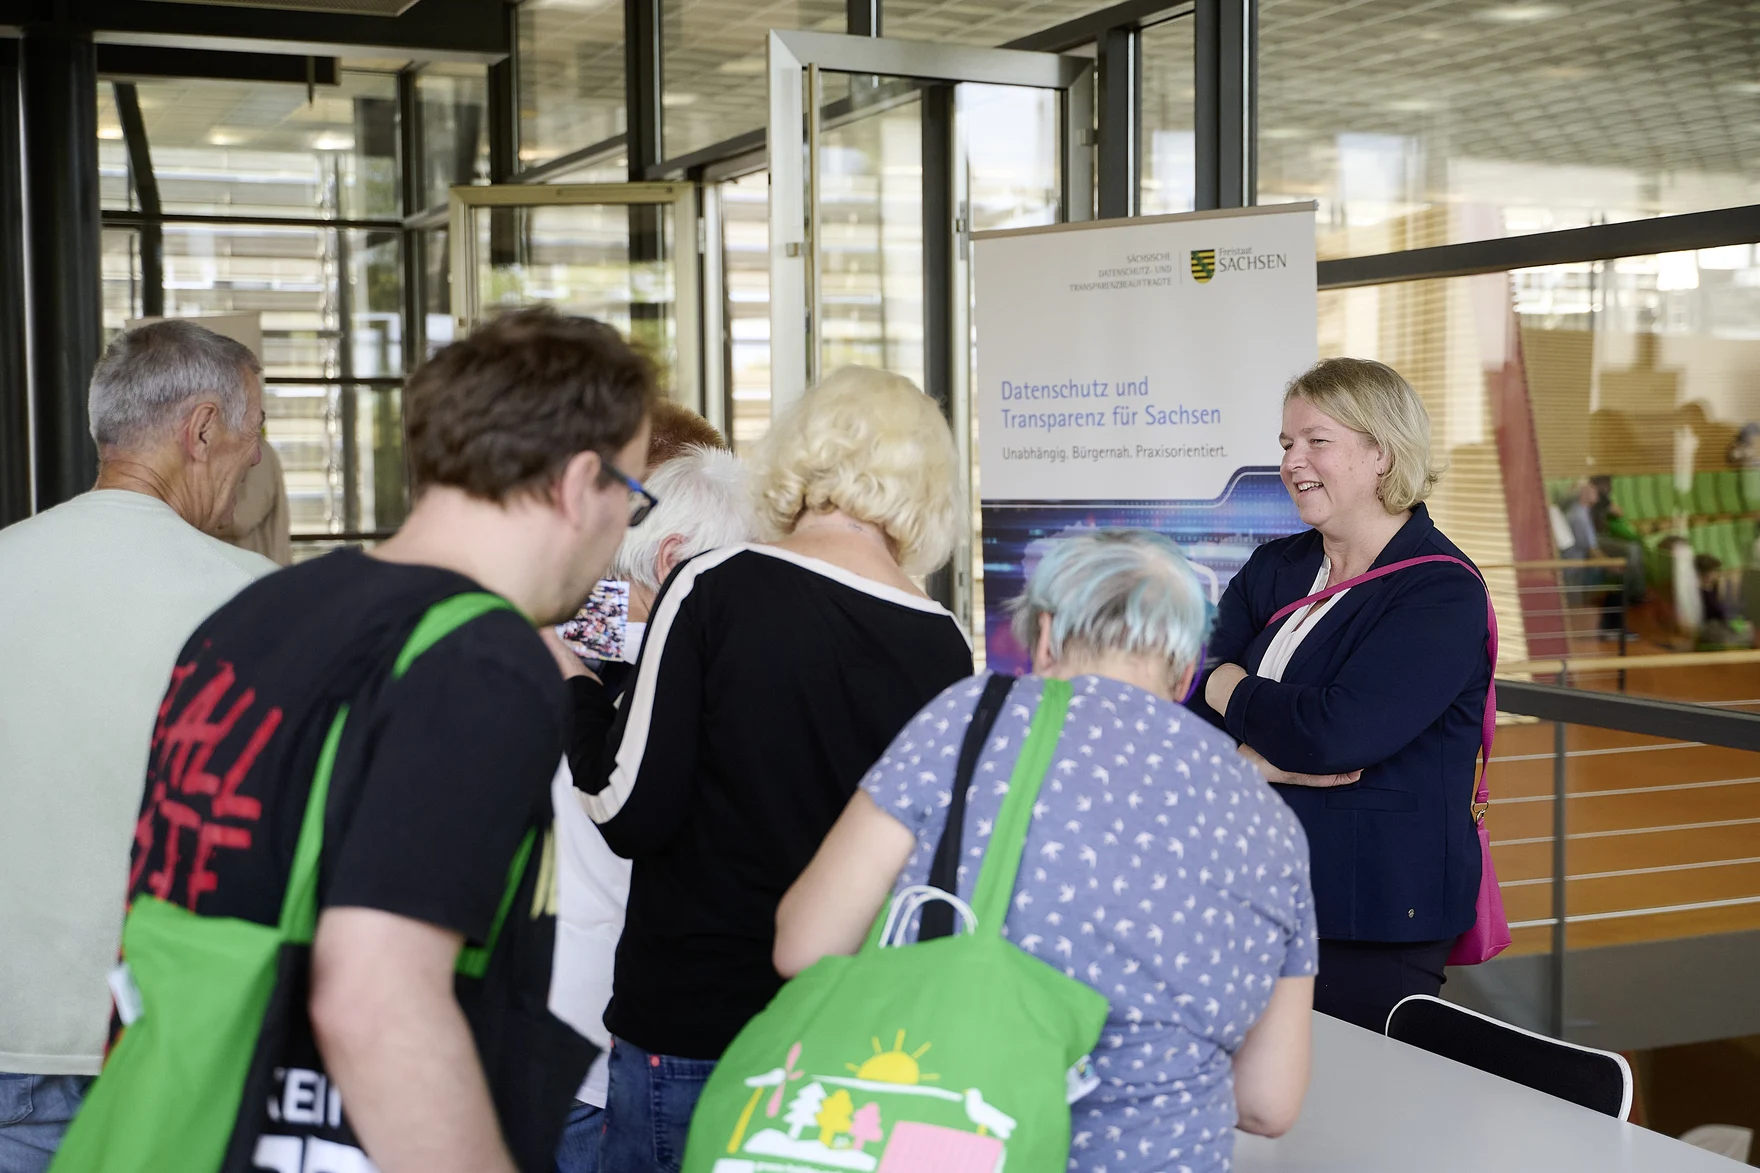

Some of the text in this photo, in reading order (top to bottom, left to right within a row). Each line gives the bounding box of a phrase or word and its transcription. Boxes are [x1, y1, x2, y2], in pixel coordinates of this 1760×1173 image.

[1155, 265, 1172, 274] UND
[1219, 253, 1287, 272] SACHSEN
[1069, 278, 1172, 292] TRANSPARENZBEAUFTRAGTE
[1001, 376, 1149, 401] Datenschutz und
[1001, 404, 1222, 432] Transparenz für Sachsen
[1002, 444, 1228, 463] Unabhängig. Bürgernah. Praxisorientiert.
